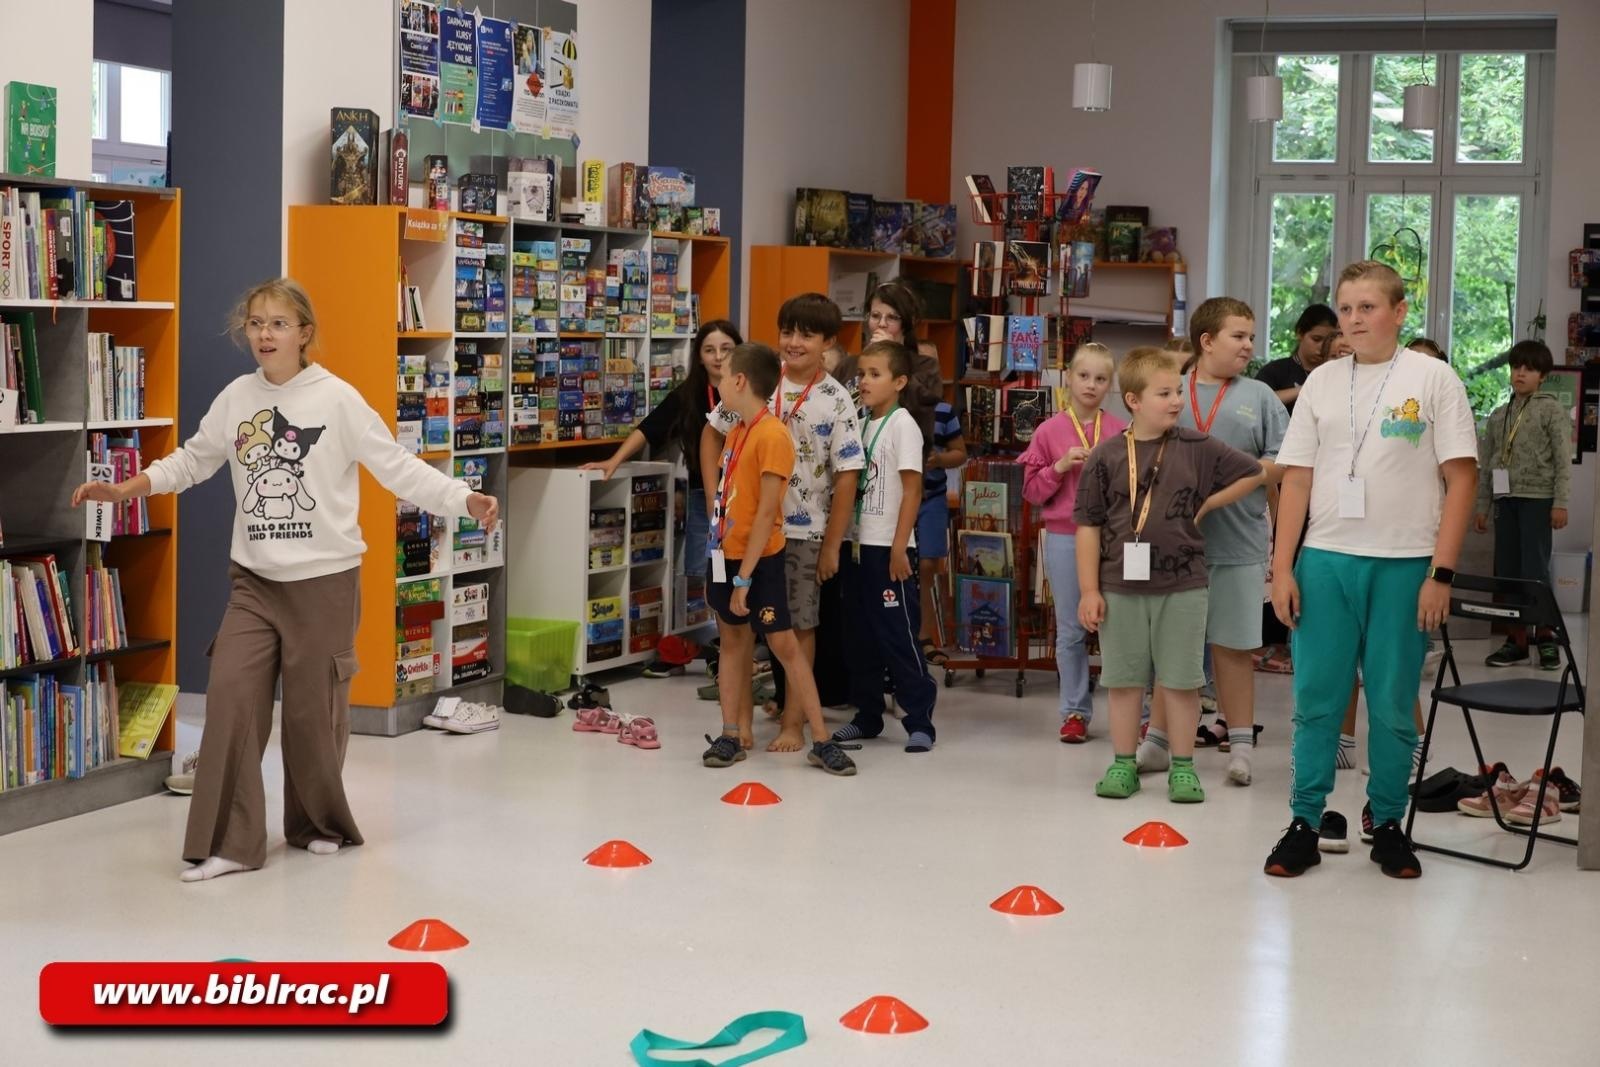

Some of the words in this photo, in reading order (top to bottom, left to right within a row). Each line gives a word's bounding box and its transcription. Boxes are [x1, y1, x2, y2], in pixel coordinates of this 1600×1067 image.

[446, 16, 472, 29] DARMOWE
[455, 29, 472, 40] KURSY
[454, 54, 473, 65] ONLINE
[336, 110, 368, 122] ANKH
[396, 148, 406, 190] CENTURY
[408, 219, 430, 230] Książka
[2, 221, 11, 270] SPORT
[971, 487, 1000, 506] Julia
[247, 523, 275, 532] HELLO
[278, 522, 311, 531] KITTY
[249, 532, 266, 541] AND
[270, 531, 313, 540] FRIENDS
[407, 661, 429, 675] Qwirkle
